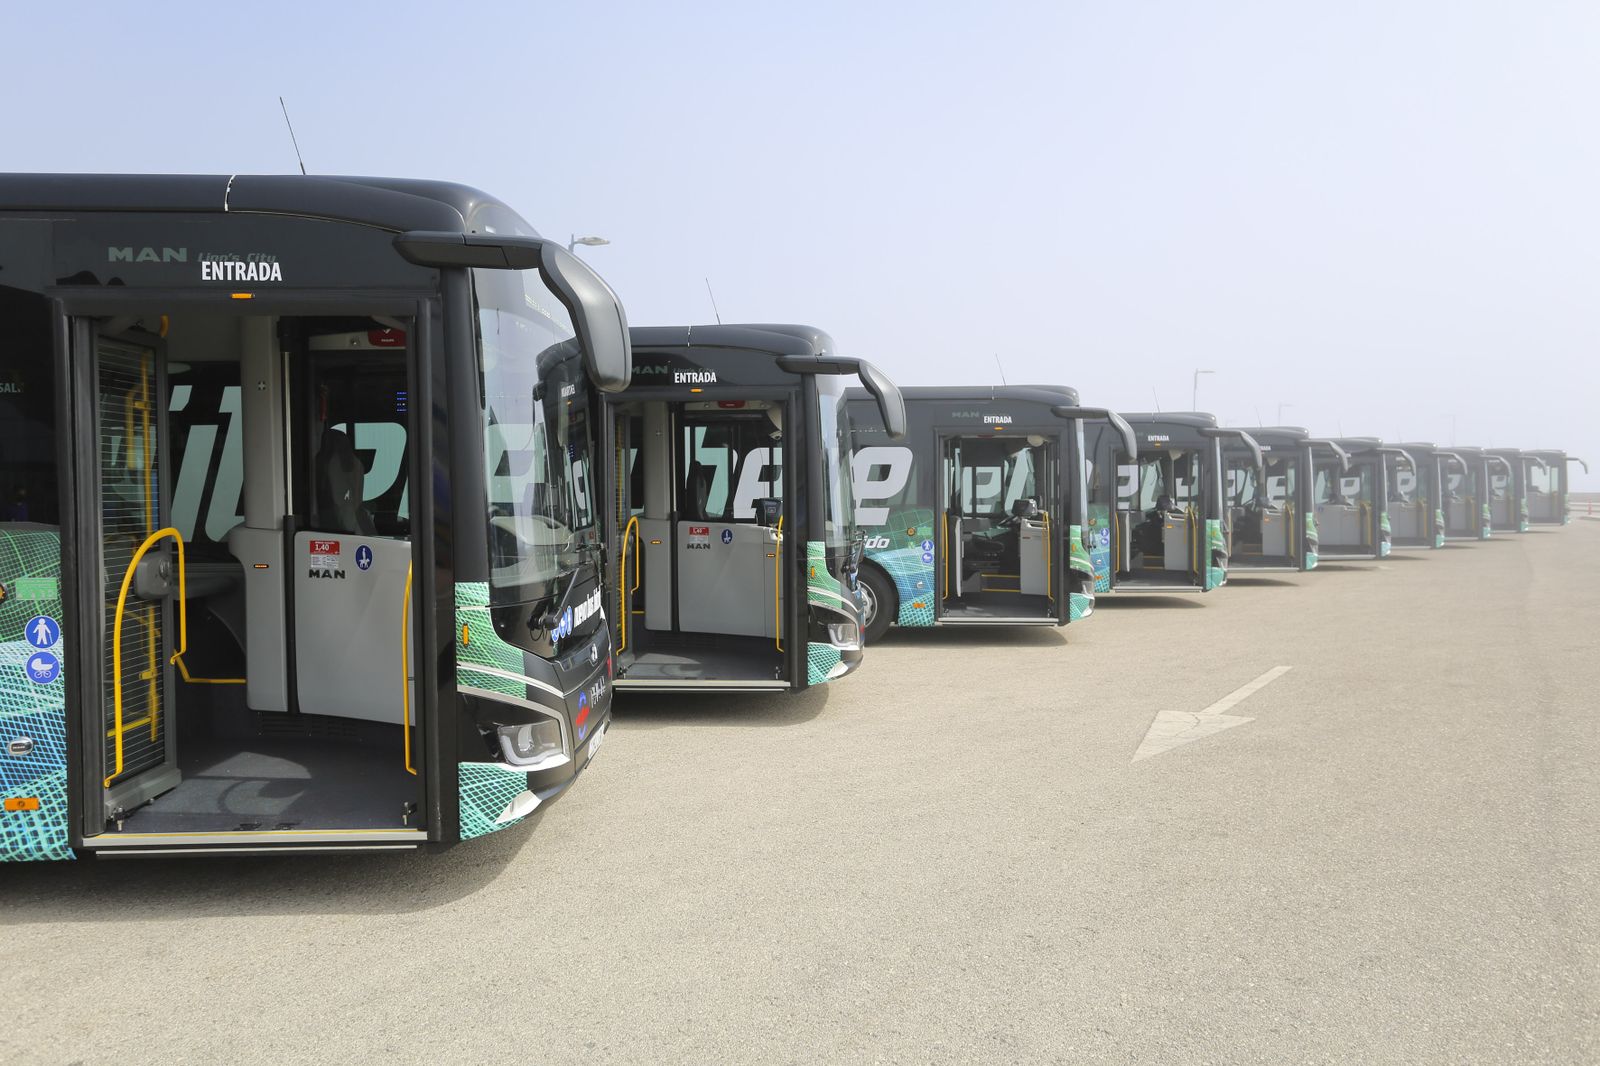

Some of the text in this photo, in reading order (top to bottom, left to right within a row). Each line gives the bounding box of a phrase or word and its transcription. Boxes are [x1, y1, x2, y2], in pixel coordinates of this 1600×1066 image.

[108, 247, 187, 262] MAN
[201, 261, 282, 281] ENTRADA
[674, 372, 717, 383] ENTRADA
[983, 415, 1013, 424] ENTRADA
[308, 569, 346, 579] MAN
